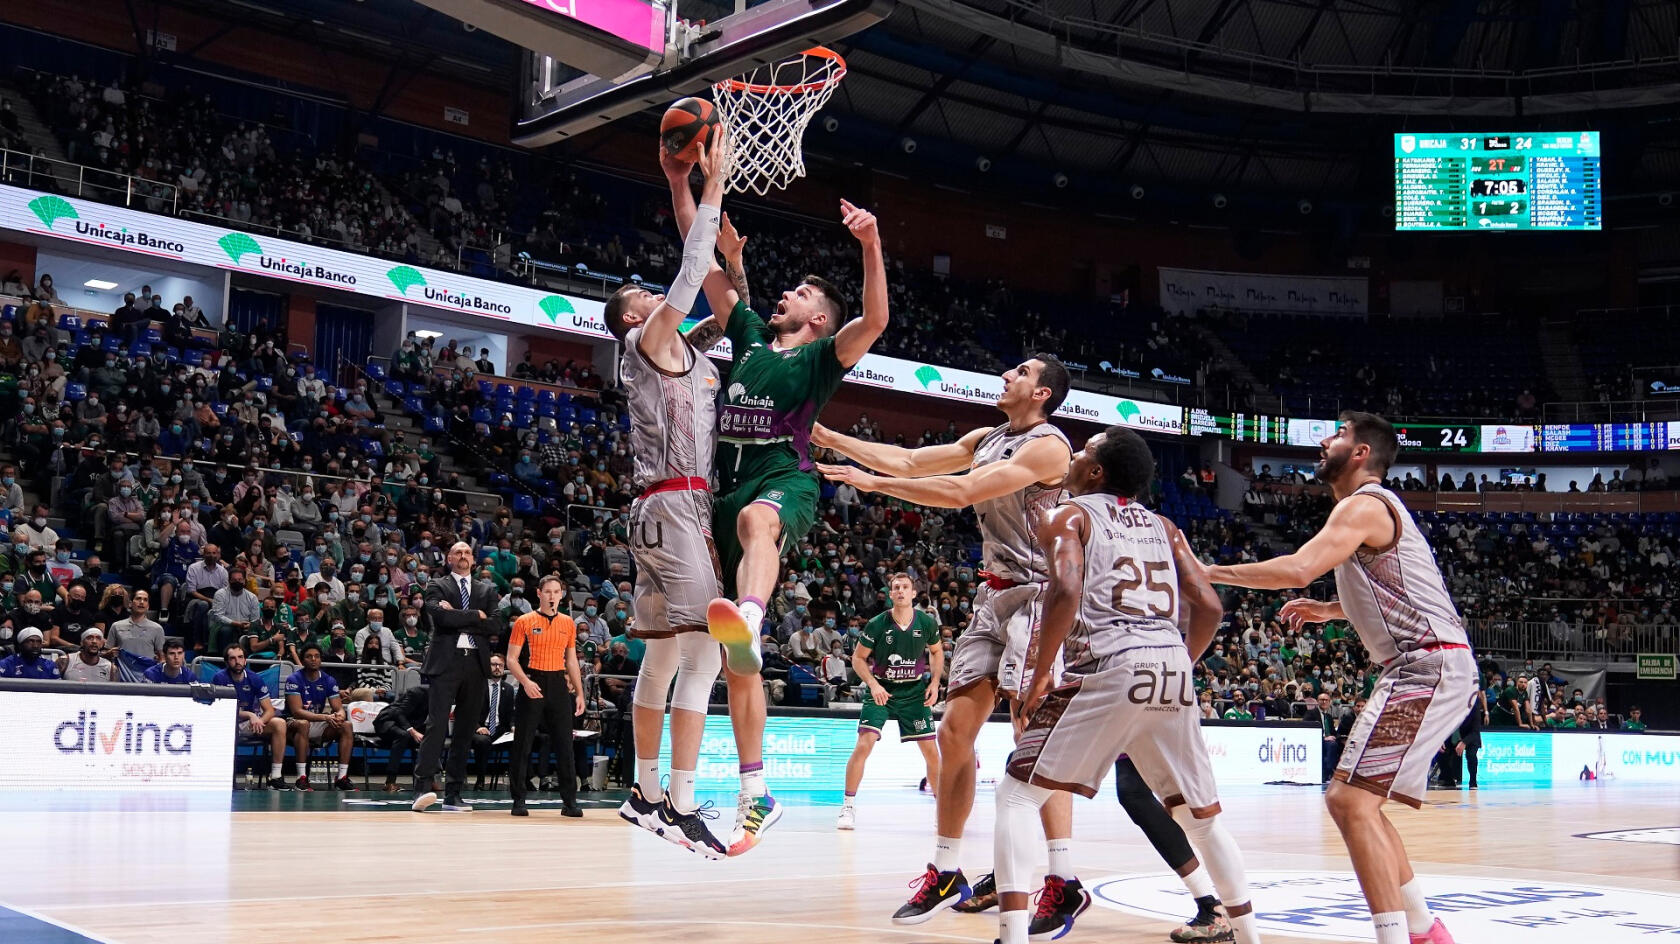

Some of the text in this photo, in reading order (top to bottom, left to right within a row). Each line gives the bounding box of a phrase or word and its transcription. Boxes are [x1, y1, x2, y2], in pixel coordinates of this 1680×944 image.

[1460, 138, 1477, 150] 31
[1516, 137, 1532, 150] 24
[1489, 159, 1506, 171] 2T
[1484, 181, 1518, 195] 7:05
[1480, 202, 1488, 214] 1
[1510, 202, 1520, 214] 2
[76, 221, 184, 253] Unicaja Banco
[260, 256, 356, 286] Unicaja Banco
[425, 288, 512, 314] Unicaja Banco
[866, 370, 894, 384] Banco
[941, 382, 1000, 400] Unicaja Banco
[1075, 404, 1100, 417] Banco
[734, 412, 772, 425] MÁLAGA
[1139, 416, 1170, 430] Unicaja
[1398, 438, 1422, 446] ndesa
[1441, 428, 1467, 446] 24
[1112, 556, 1174, 618] 25
[54, 711, 194, 754] divina
[766, 734, 816, 754] Salud
[1258, 738, 1307, 763] divina
[1487, 744, 1536, 759] Seguro Salud
[1622, 751, 1642, 765] CON
[122, 763, 191, 782] seguros
